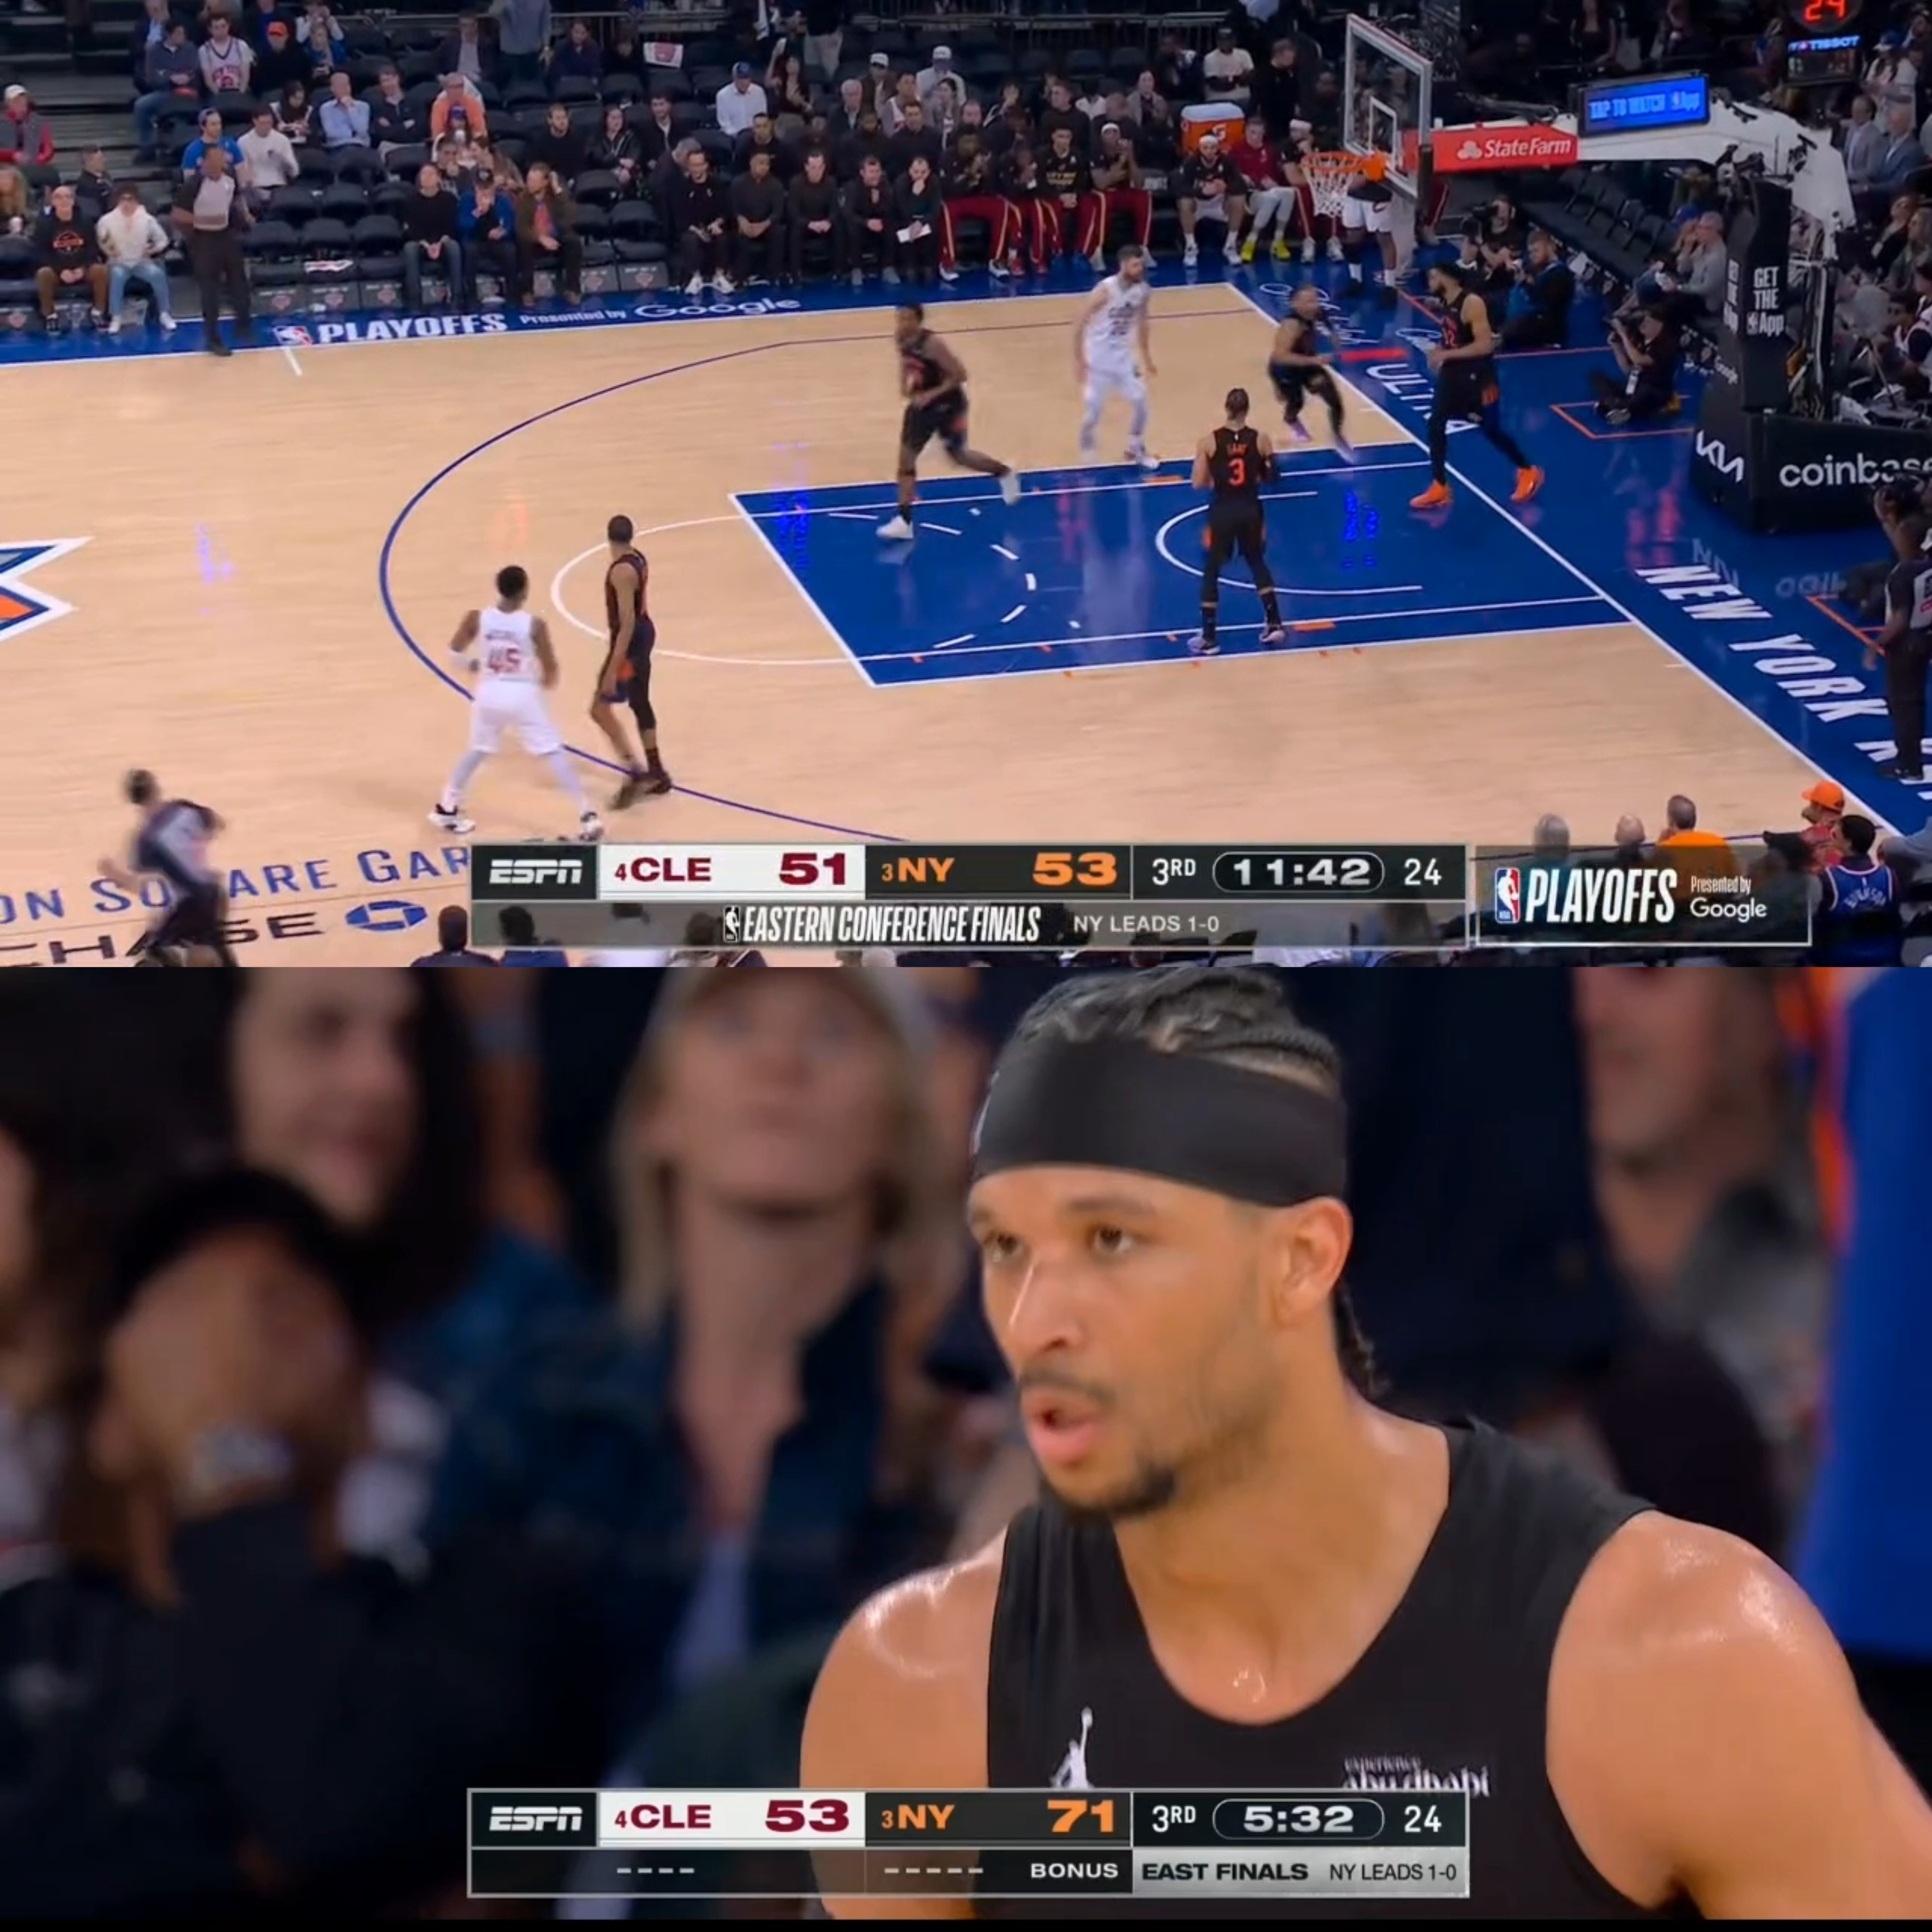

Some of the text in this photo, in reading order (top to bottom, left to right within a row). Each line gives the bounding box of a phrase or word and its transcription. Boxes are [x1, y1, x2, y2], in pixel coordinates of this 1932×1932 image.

[1754, 266, 1780, 289] GET
[1752, 288, 1779, 310] THE
[317, 298, 801, 344] PLAYOFFS Presented by Google
[1759, 311, 1784, 337] App
[1228, 458, 1247, 487] 3
[1779, 452, 1932, 488] coinbas
[1635, 565, 1890, 723] NEW YORK
[90, 859, 337, 913] SQARE
[0, 912, 326, 967] HSE
